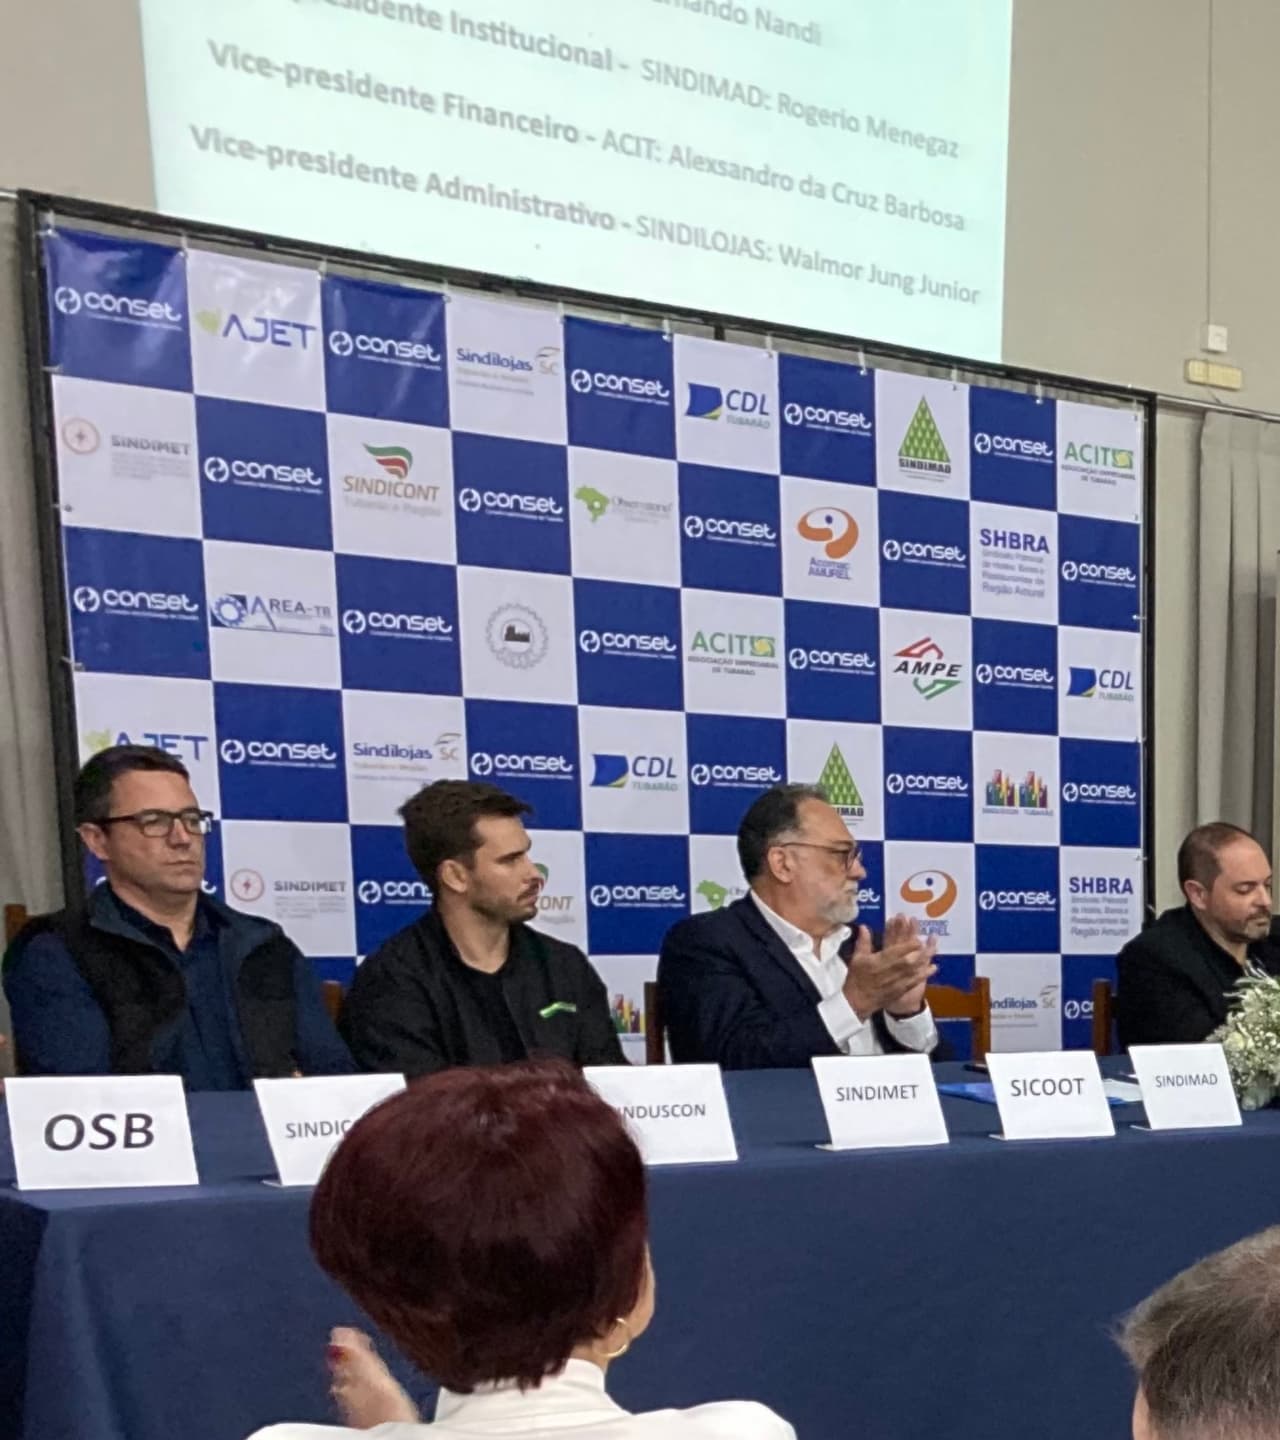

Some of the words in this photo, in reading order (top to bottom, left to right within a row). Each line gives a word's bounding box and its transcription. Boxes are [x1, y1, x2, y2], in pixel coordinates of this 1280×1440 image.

[754, 7, 823, 47] Nandi
[449, 10, 614, 71] Institucional
[640, 58, 772, 111] SINDIMAD:
[777, 92, 861, 134] Rogerio
[865, 115, 960, 159] Menegaz
[206, 38, 438, 113] Vice-presidente
[442, 91, 580, 145] Financeiro
[601, 128, 663, 162] ACIT:
[668, 144, 795, 194] Alexsandro
[799, 175, 826, 200] da
[831, 182, 879, 212] Cruz
[884, 193, 966, 231] Barbosa
[189, 123, 419, 193] Vice-presidente
[424, 171, 616, 231] Administrativo
[635, 214, 773, 263] SINDILOJAS:
[778, 243, 864, 281] Walmor
[867, 264, 915, 297] Jung
[919, 275, 981, 305] Junior
[85, 290, 182, 323] conset
[222, 313, 317, 350] AJET
[356, 333, 442, 363] conset
[456, 347, 533, 372] Sindilojas
[594, 371, 670, 399] conset
[726, 389, 770, 416] CDL
[804, 406, 872, 430] conset
[111, 433, 192, 457] SINDIMET
[993, 434, 1054, 457] conset
[1064, 441, 1111, 467] ACIT
[231, 459, 323, 487] conset
[343, 475, 441, 502] SINDICONT
[484, 490, 563, 516] conset
[706, 519, 777, 540] conset
[902, 541, 967, 562] conset
[979, 527, 1051, 555] SHBRA
[1079, 562, 1136, 582] conset
[103, 588, 199, 613] conset
[368, 610, 453, 634] conset
[602, 631, 677, 652] conset
[691, 631, 749, 656] ACIT
[809, 649, 876, 669] conset
[893, 660, 963, 678] AMPE
[993, 664, 1055, 684] conset
[1099, 669, 1135, 691] CDL
[247, 741, 337, 761] conset
[353, 742, 433, 761] Sindilojas
[494, 753, 574, 773] conset
[632, 756, 678, 779] CDL
[711, 764, 782, 782] conset
[905, 775, 968, 790] conset
[1079, 784, 1137, 799] conset
[837, 806, 865, 818] IMAD
[274, 880, 347, 893] SINDIMET
[611, 884, 686, 902] conset
[1069, 876, 1134, 895] SHBRA
[996, 890, 1057, 906] conset
[990, 997, 1038, 1011] ndilojas
[1010, 1077, 1085, 1098] SICOOT
[1154, 1073, 1219, 1089] SINDIMAD
[836, 1084, 919, 1102] SINDIMET
[44, 1111, 155, 1151] OSB
[285, 1119, 355, 1139] SINDIC
